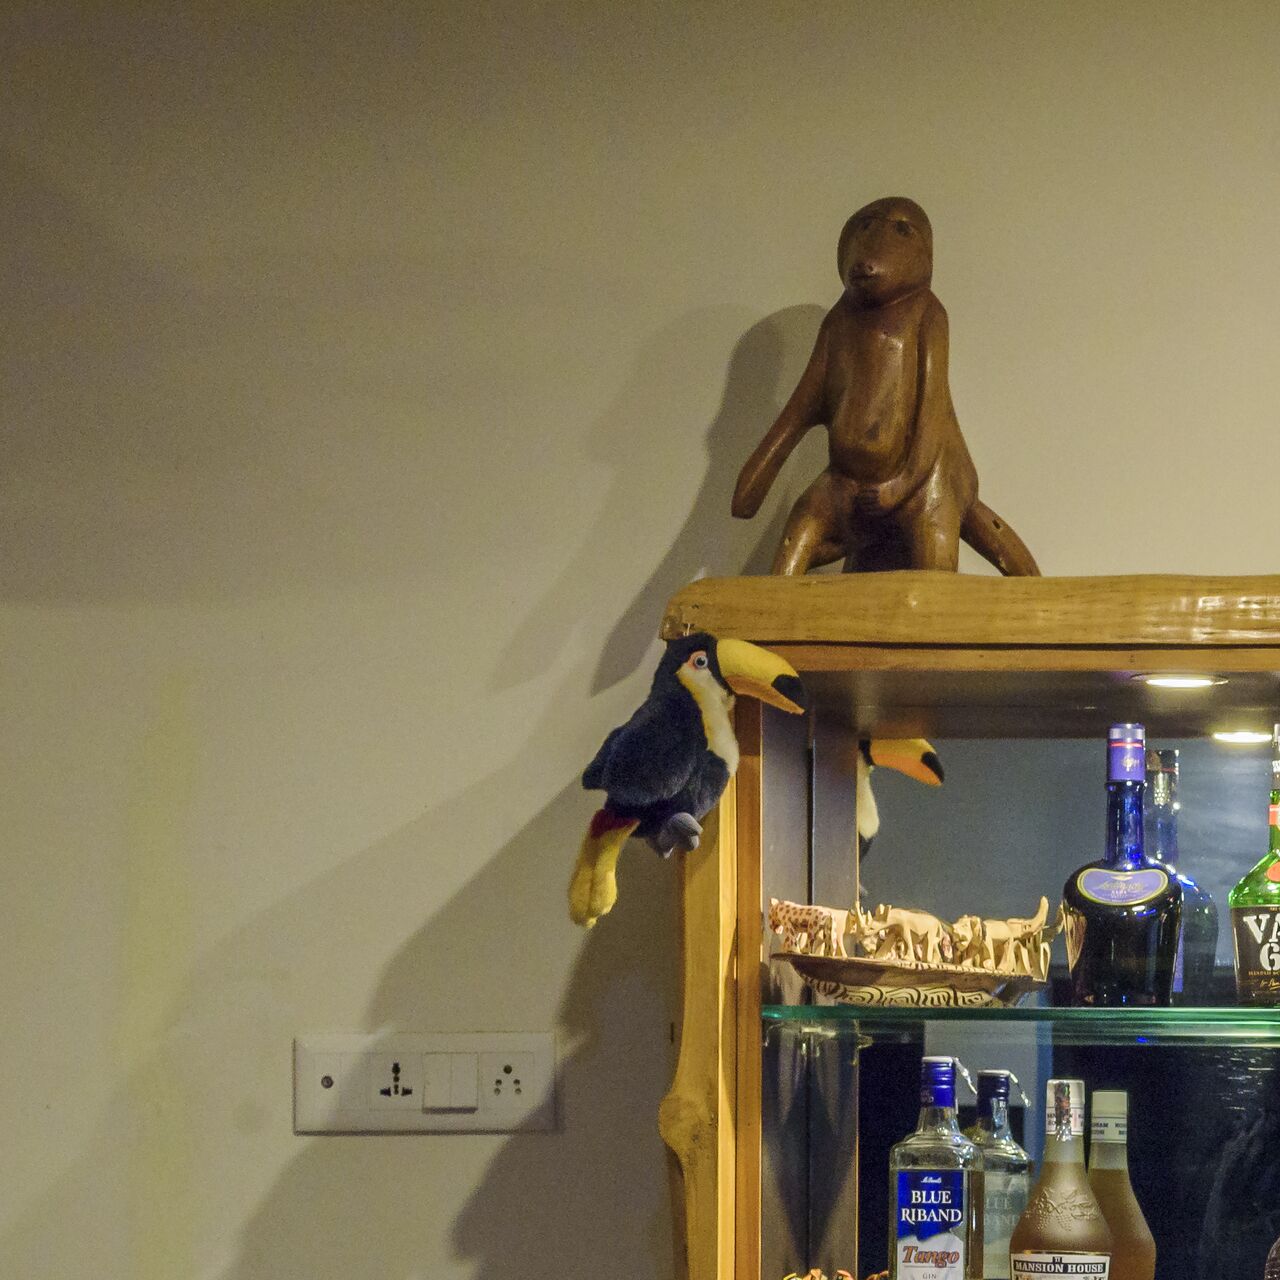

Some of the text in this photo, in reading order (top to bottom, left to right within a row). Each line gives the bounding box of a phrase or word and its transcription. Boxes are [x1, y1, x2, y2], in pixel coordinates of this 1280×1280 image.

[911, 1190, 952, 1204] BLUE
[901, 1208, 962, 1225] RIBAND
[902, 1246, 960, 1268] Tango
[1015, 1261, 1104, 1273] MANSION HOUSE
